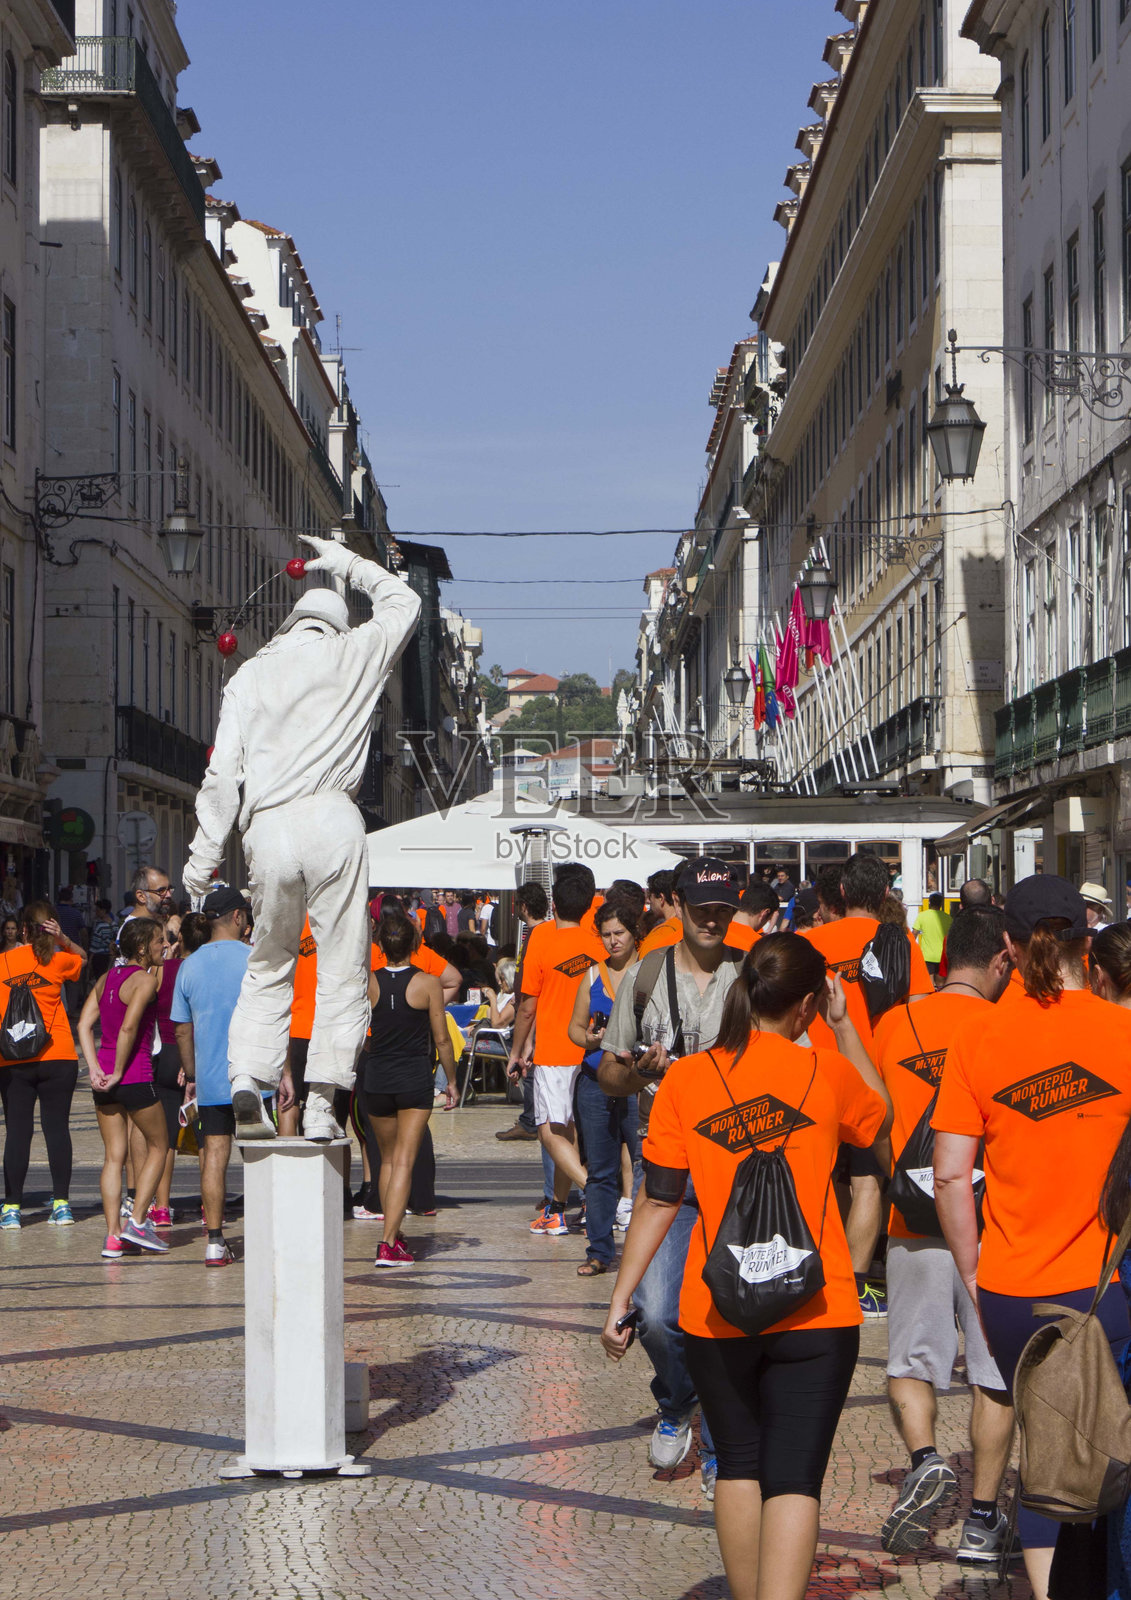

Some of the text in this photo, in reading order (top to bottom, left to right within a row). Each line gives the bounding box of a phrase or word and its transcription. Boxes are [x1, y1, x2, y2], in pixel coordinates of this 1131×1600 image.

[1011, 1069, 1073, 1105] MONTEPIO
[1029, 1078, 1088, 1112] RUNNER
[710, 1101, 770, 1136] MONTEPIO
[728, 1110, 784, 1144] RUNNER
